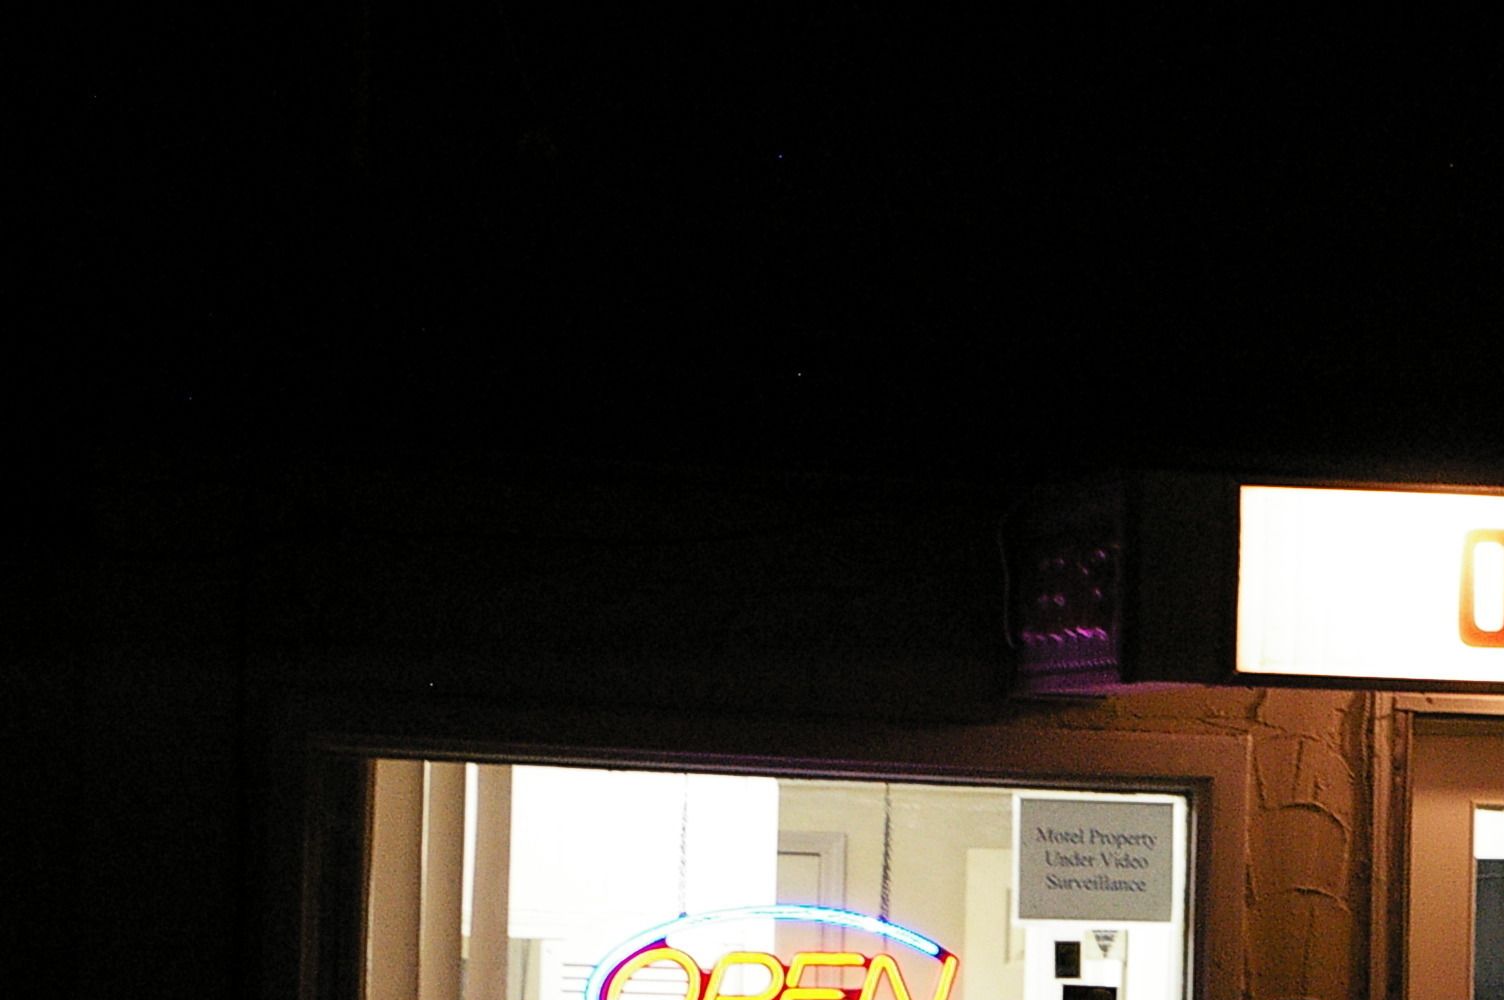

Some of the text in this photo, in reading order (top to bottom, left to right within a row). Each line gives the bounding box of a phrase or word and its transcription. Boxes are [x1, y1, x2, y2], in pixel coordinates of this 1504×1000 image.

[1035, 827, 1157, 850] Motel Property
[1044, 850, 1149, 870] Under Video
[1045, 873, 1147, 893] Surveillance
